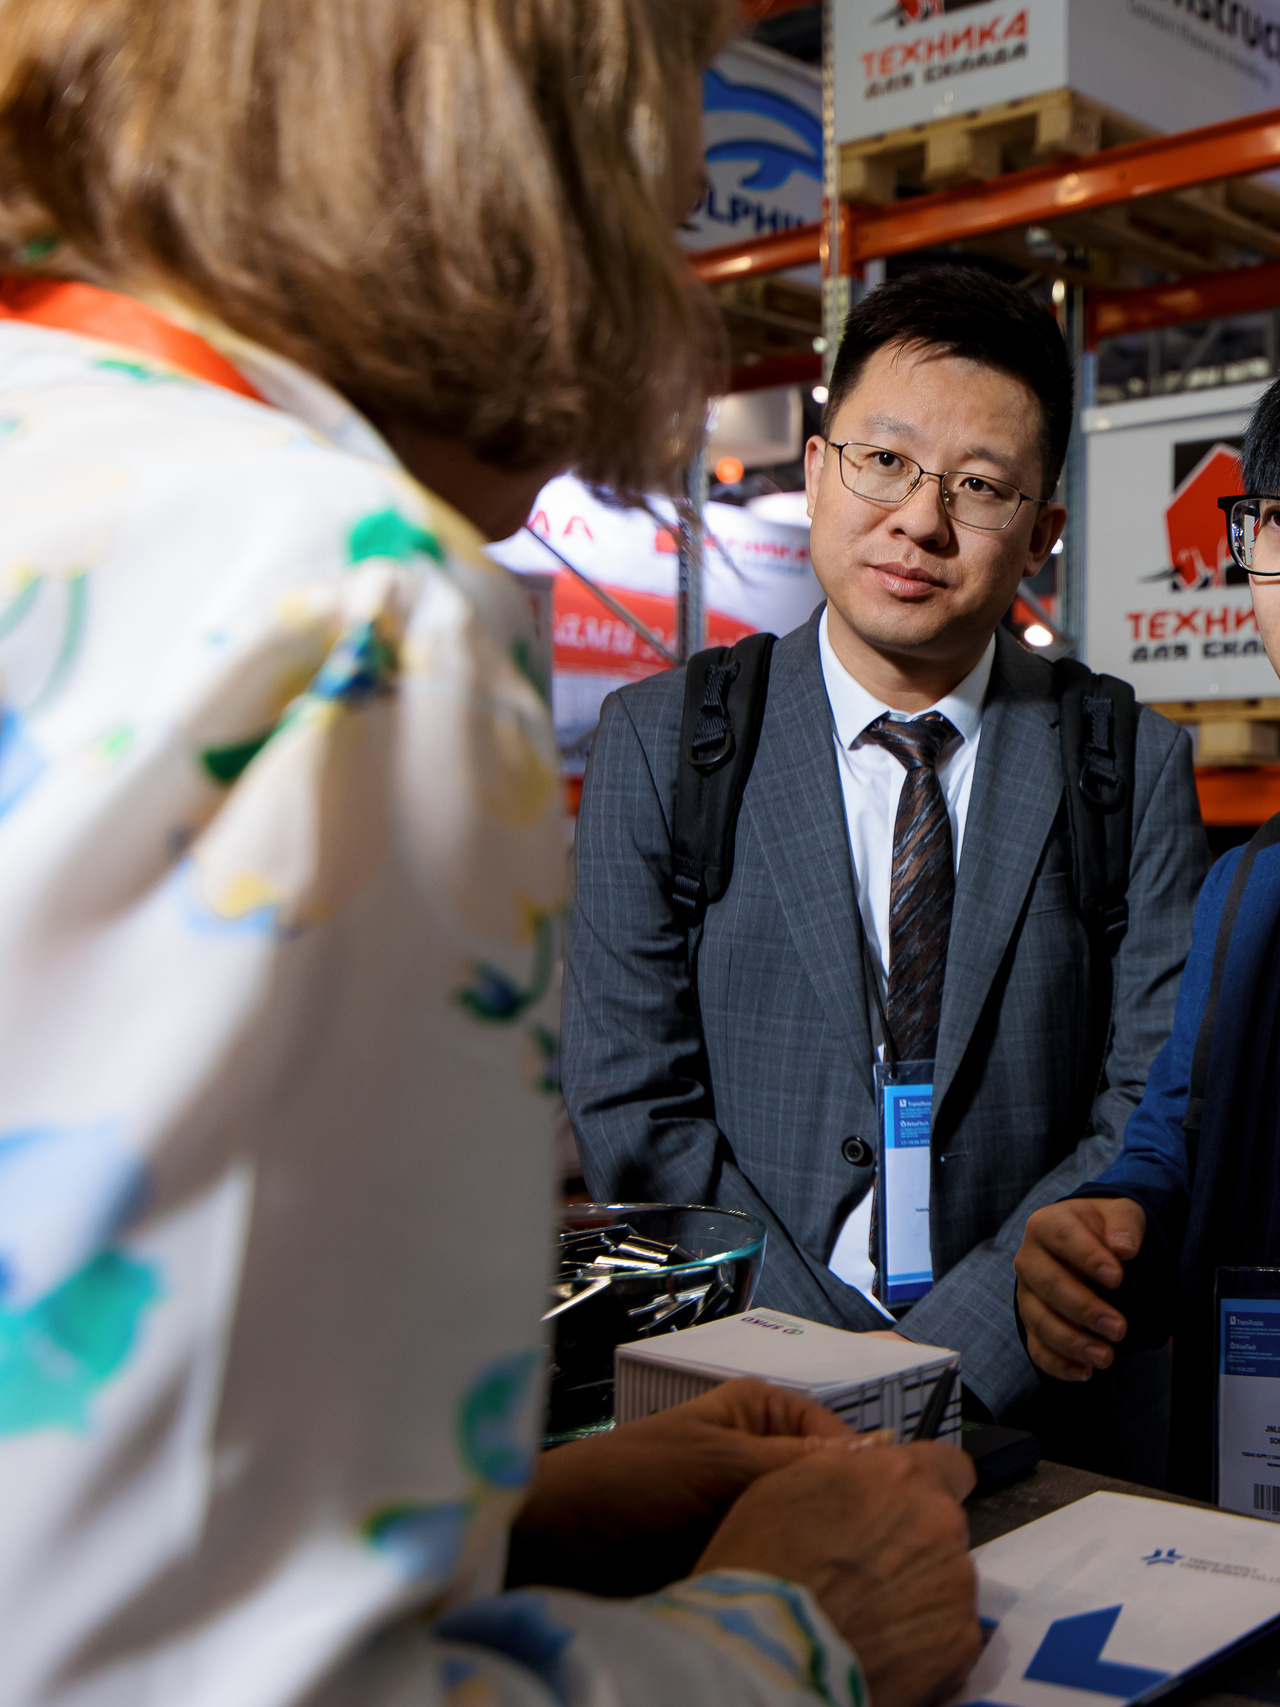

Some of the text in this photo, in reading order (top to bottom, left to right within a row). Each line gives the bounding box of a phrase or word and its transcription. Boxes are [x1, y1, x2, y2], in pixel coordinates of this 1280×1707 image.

[859, 8, 1029, 80] ТЕХНИКА
[865, 42, 1029, 100] ДЛЯ СКЛАДА
[1131, 639, 1268, 663] ДЛЯ СКЛ
